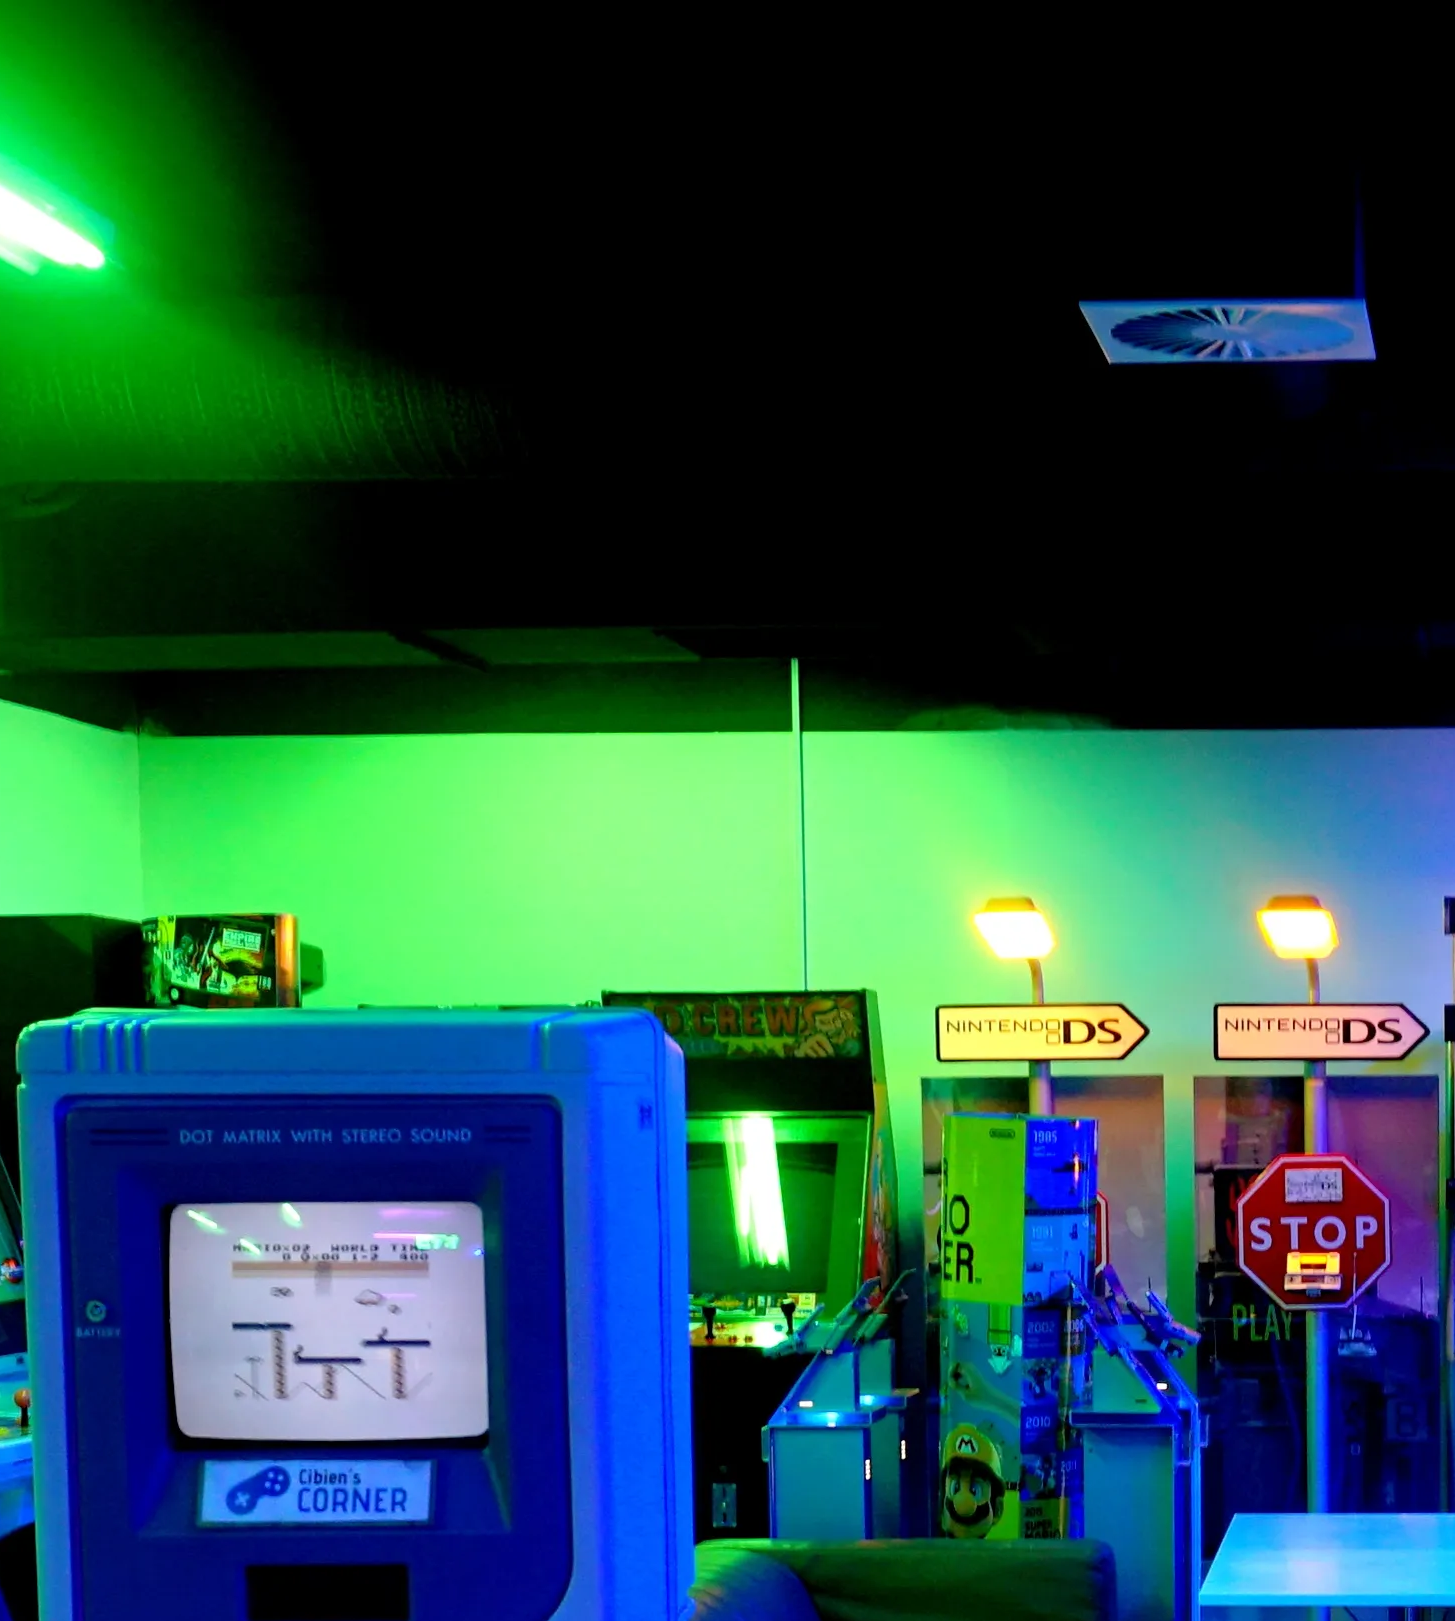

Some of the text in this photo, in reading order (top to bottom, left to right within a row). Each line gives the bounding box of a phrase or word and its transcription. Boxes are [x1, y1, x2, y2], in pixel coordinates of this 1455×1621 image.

[946, 1018, 1123, 1045] NINTENDO DS
[1224, 1018, 1403, 1044] NINTENDO DS
[180, 1128, 472, 1145] DOT MATRIX WITH STEREO SOUND
[1250, 1215, 1378, 1252] STOP
[330, 1244, 380, 1252] WORLD
[1232, 1303, 1292, 1342] PLAY
[1025, 1415, 1051, 1429] 2010
[297, 1487, 408, 1514] CORNER
